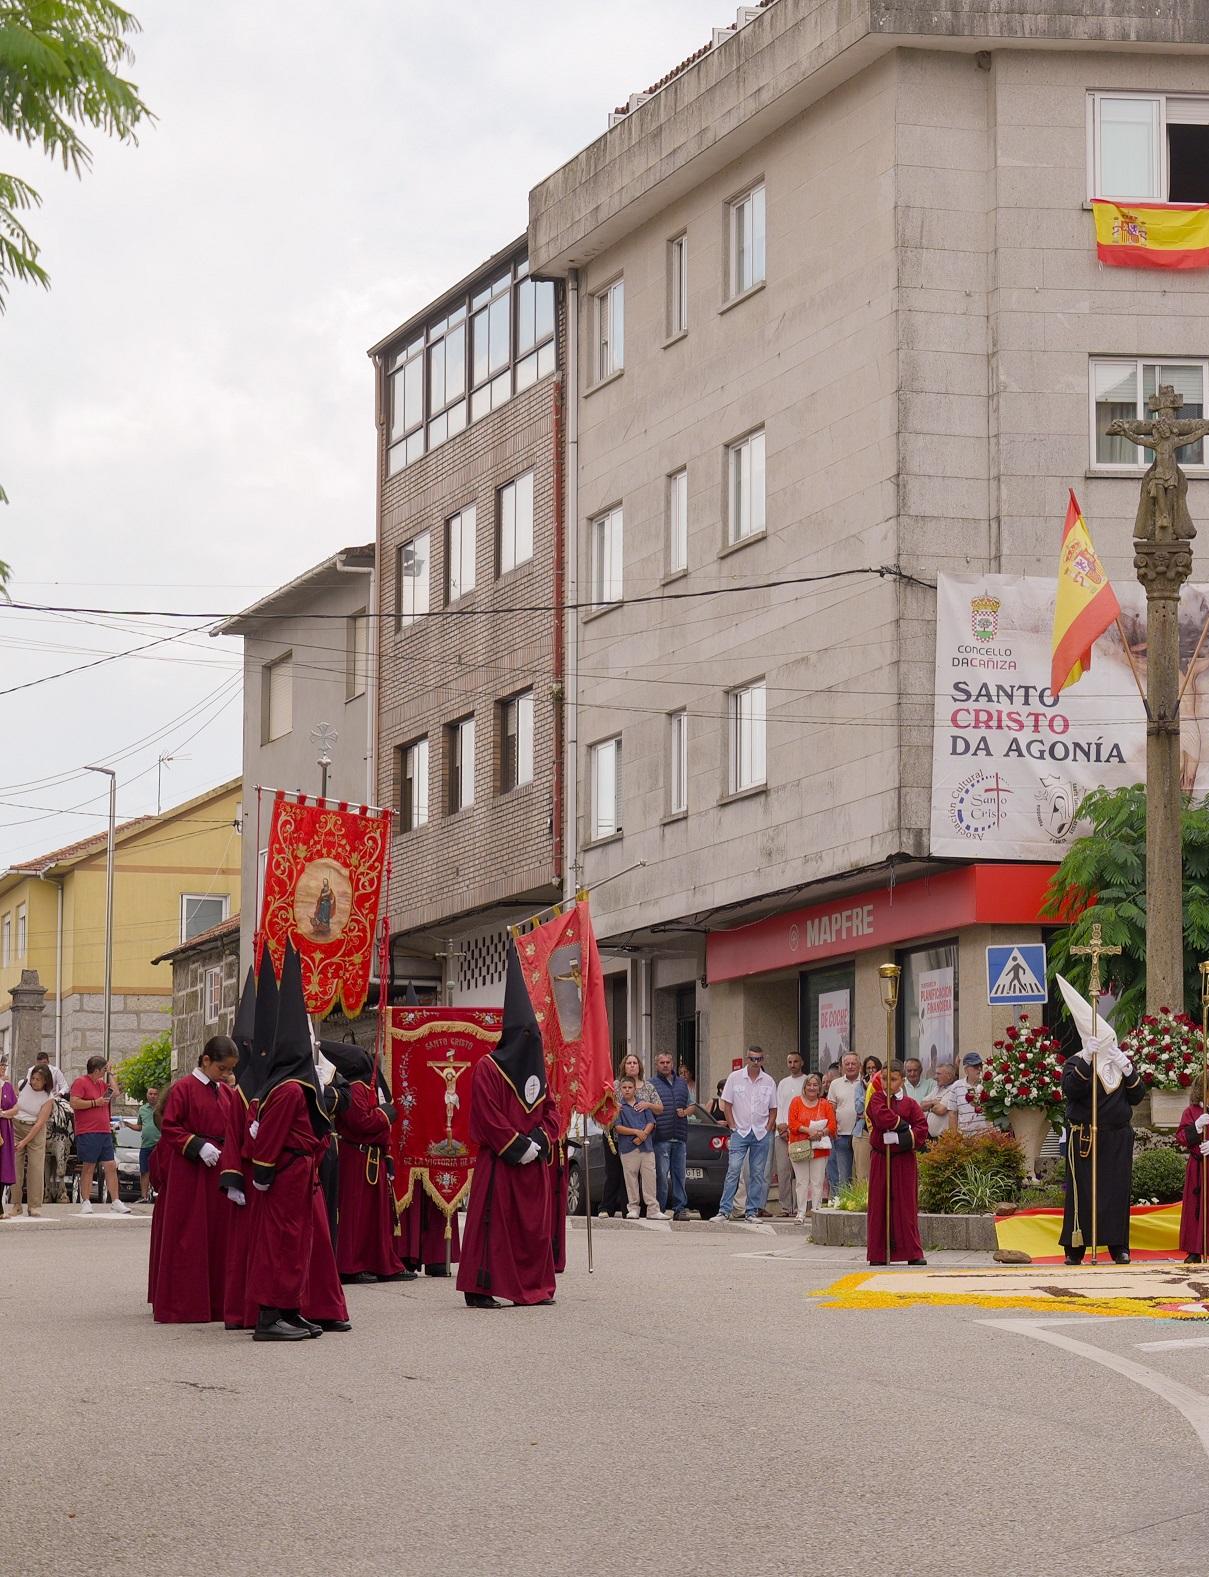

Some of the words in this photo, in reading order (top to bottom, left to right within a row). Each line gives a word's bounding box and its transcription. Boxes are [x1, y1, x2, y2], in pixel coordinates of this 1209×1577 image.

[951, 681, 1060, 708] SANTO
[950, 708, 1070, 735] CRISTO
[950, 735, 994, 757] DA
[1003, 736, 1127, 764] AGONÍA
[951, 768, 984, 799] Cultural
[806, 904, 874, 948] MAPFRE
[821, 1010, 829, 1029] DE
[829, 1008, 849, 1028] COCHE
[425, 1038, 448, 1051] SANTO
[450, 1037, 474, 1050] CRISTO
